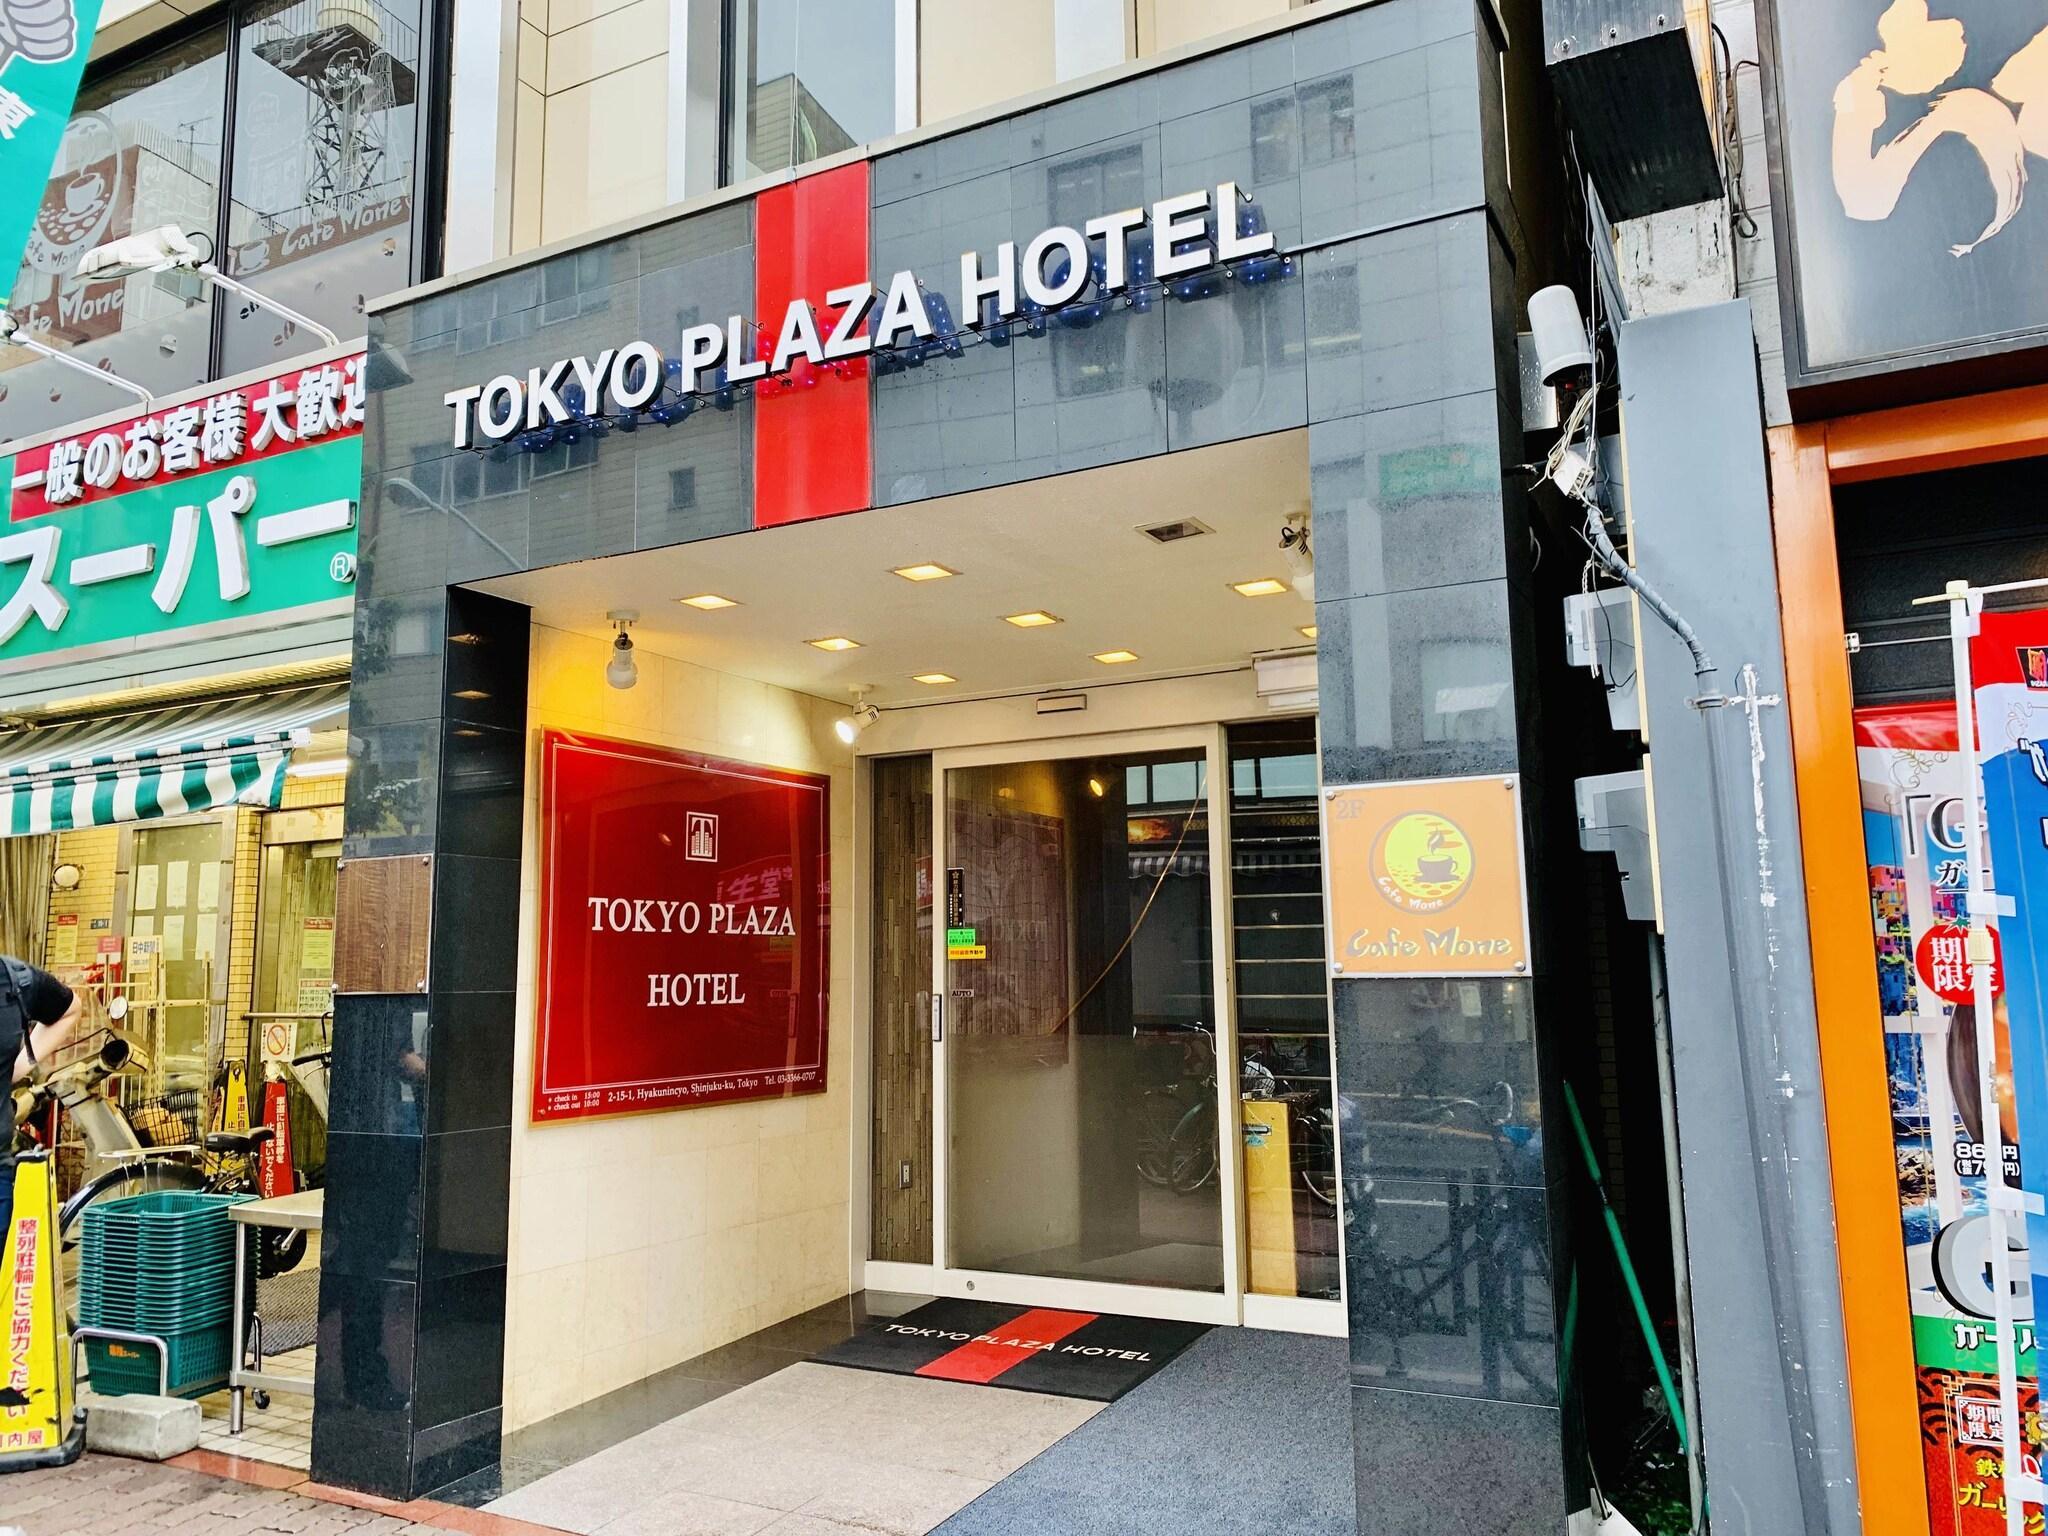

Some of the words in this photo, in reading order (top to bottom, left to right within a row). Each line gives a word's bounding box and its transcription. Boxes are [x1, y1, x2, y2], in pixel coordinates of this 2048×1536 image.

[281, 222, 335, 256] Cafe
[338, 197, 402, 234] Mone
[58, 284, 125, 328] Mone
[443, 341, 664, 450] TOKYO
[681, 270, 936, 395] PLAZA
[961, 181, 1277, 327] HOTEL
[0, 475, 357, 650] スーパー
[1336, 798, 1366, 820] 2F
[1377, 876, 1403, 903] Cafe
[1408, 898, 1444, 910] Mone
[588, 897, 700, 934] TOKYO
[708, 903, 796, 936] PLAZA
[1346, 928, 1420, 958] Cafe
[1423, 926, 1512, 957] Mone
[647, 973, 746, 1007] HOTEL
[608, 1091, 635, 1103] 2-15-1,
[637, 1084, 690, 1099] Hyakunincyo,
[691, 1080, 736, 1094] Shinjuku-ku,
[738, 1077, 758, 1089] Tokyo
[764, 1074, 776, 1086] Tel.
[553, 1102, 571, 1111] check
[571, 1101, 581, 1110] out
[554, 1094, 571, 1103] check
[571, 1093, 578, 1101] in
[1956, 1143, 2018, 1159] 86円
[884, 1324, 970, 1341] TOKYO
[969, 1334, 1056, 1351] PLAZA
[1060, 1344, 1152, 1363] HOTEL
